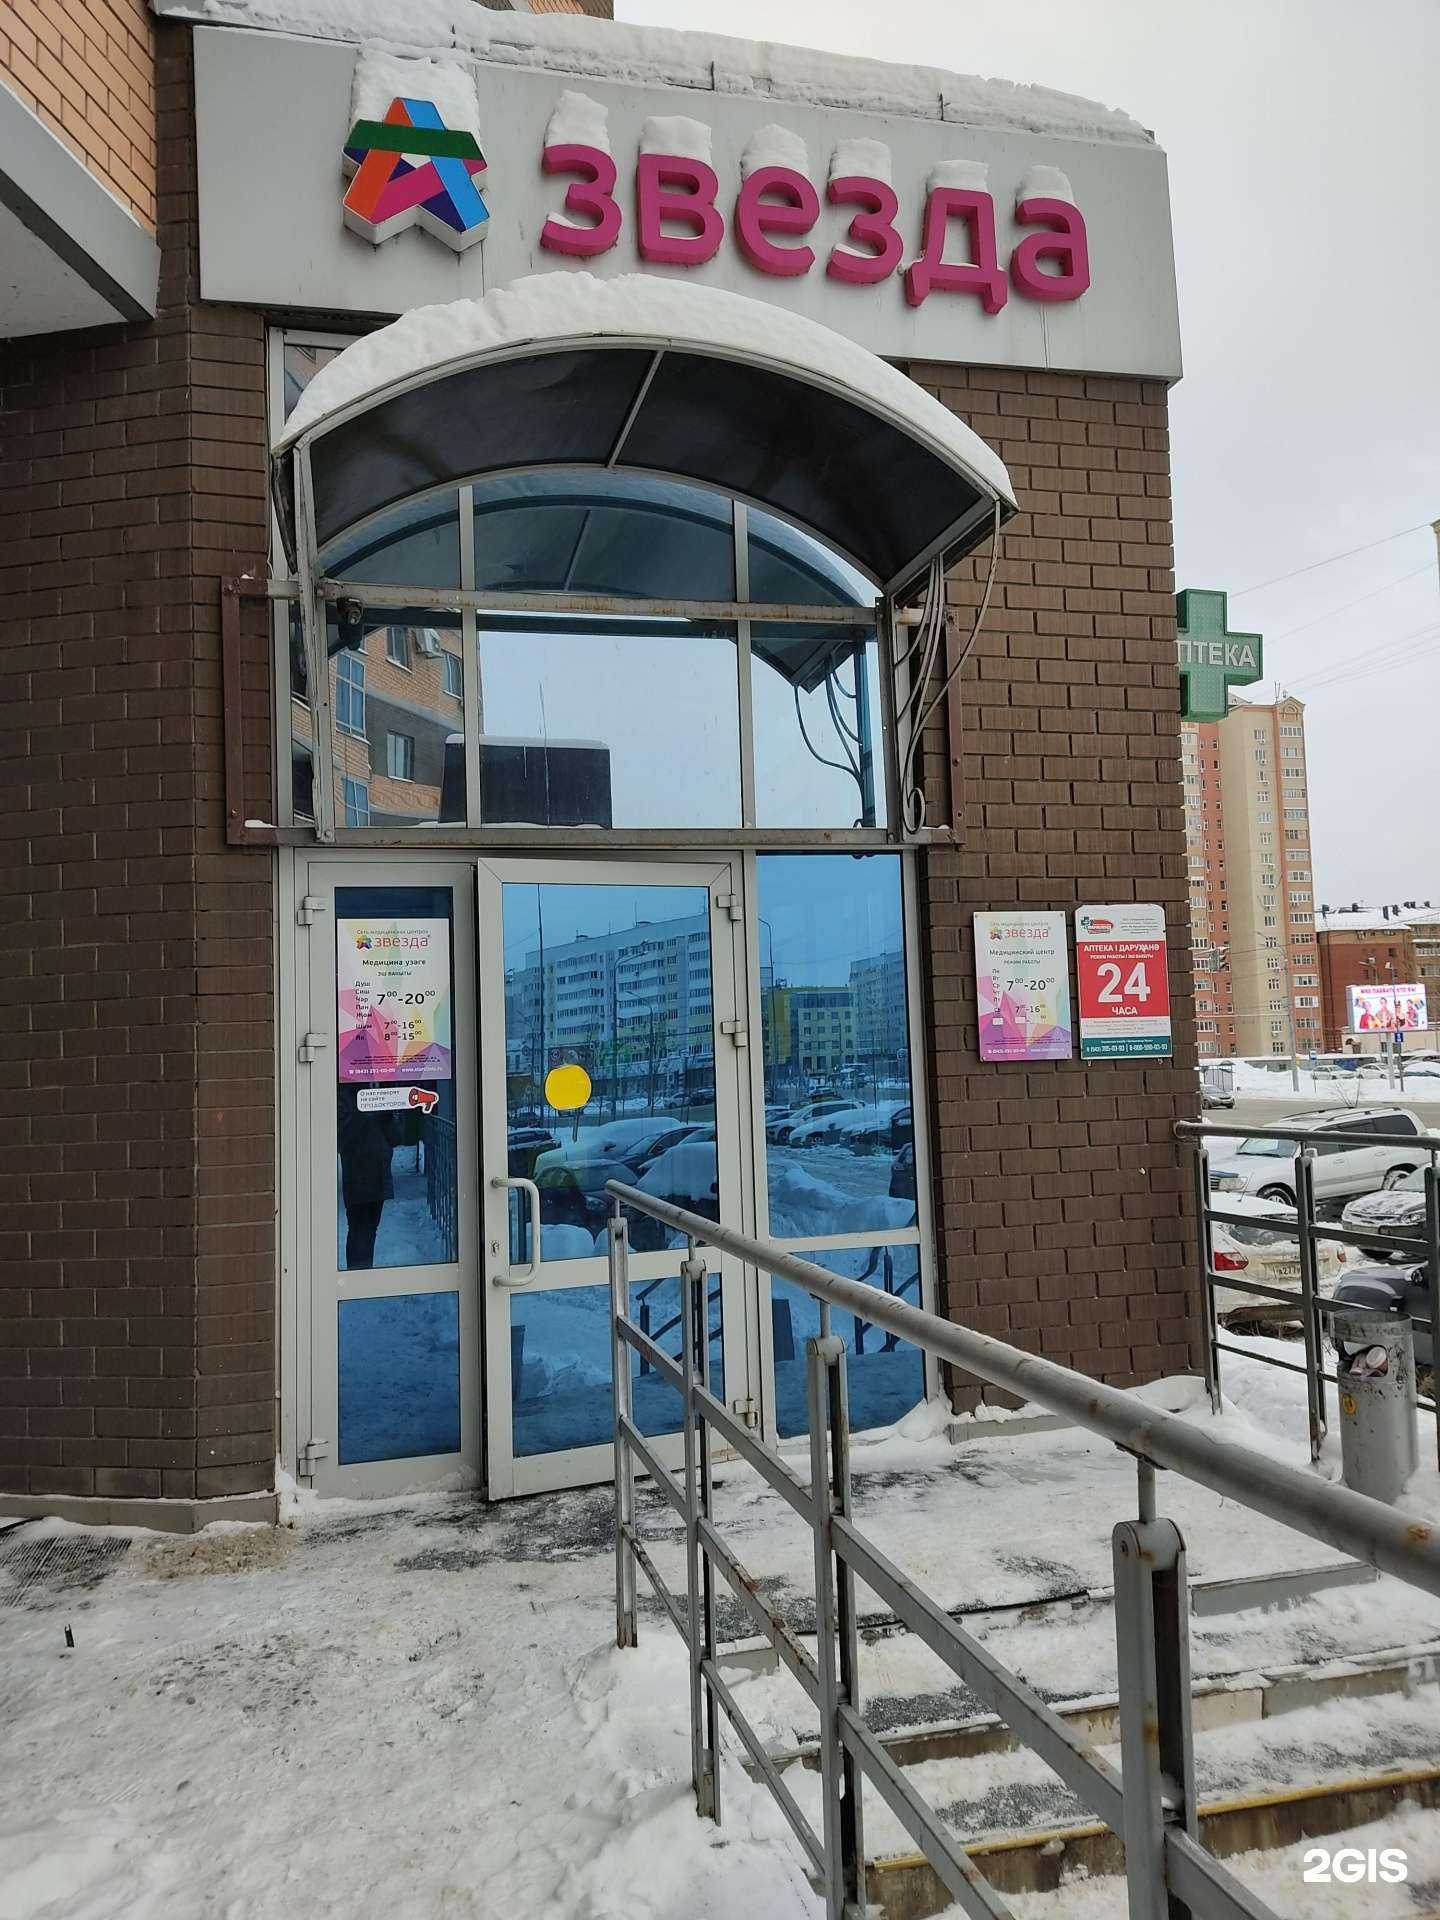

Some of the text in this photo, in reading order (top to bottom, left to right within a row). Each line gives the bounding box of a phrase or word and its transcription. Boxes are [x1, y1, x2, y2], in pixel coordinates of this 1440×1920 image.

[1176, 640, 1257, 668] ПТЕКА
[1004, 928, 1049, 940] звезда
[374, 936, 428, 949] звезда
[989, 948, 1034, 956] Медицинский
[1084, 944, 1114, 952] АПТЕКА
[362, 959, 403, 967] Медицина
[1097, 962, 1151, 1003] 24
[1112, 1006, 1138, 1015] ЧАСА
